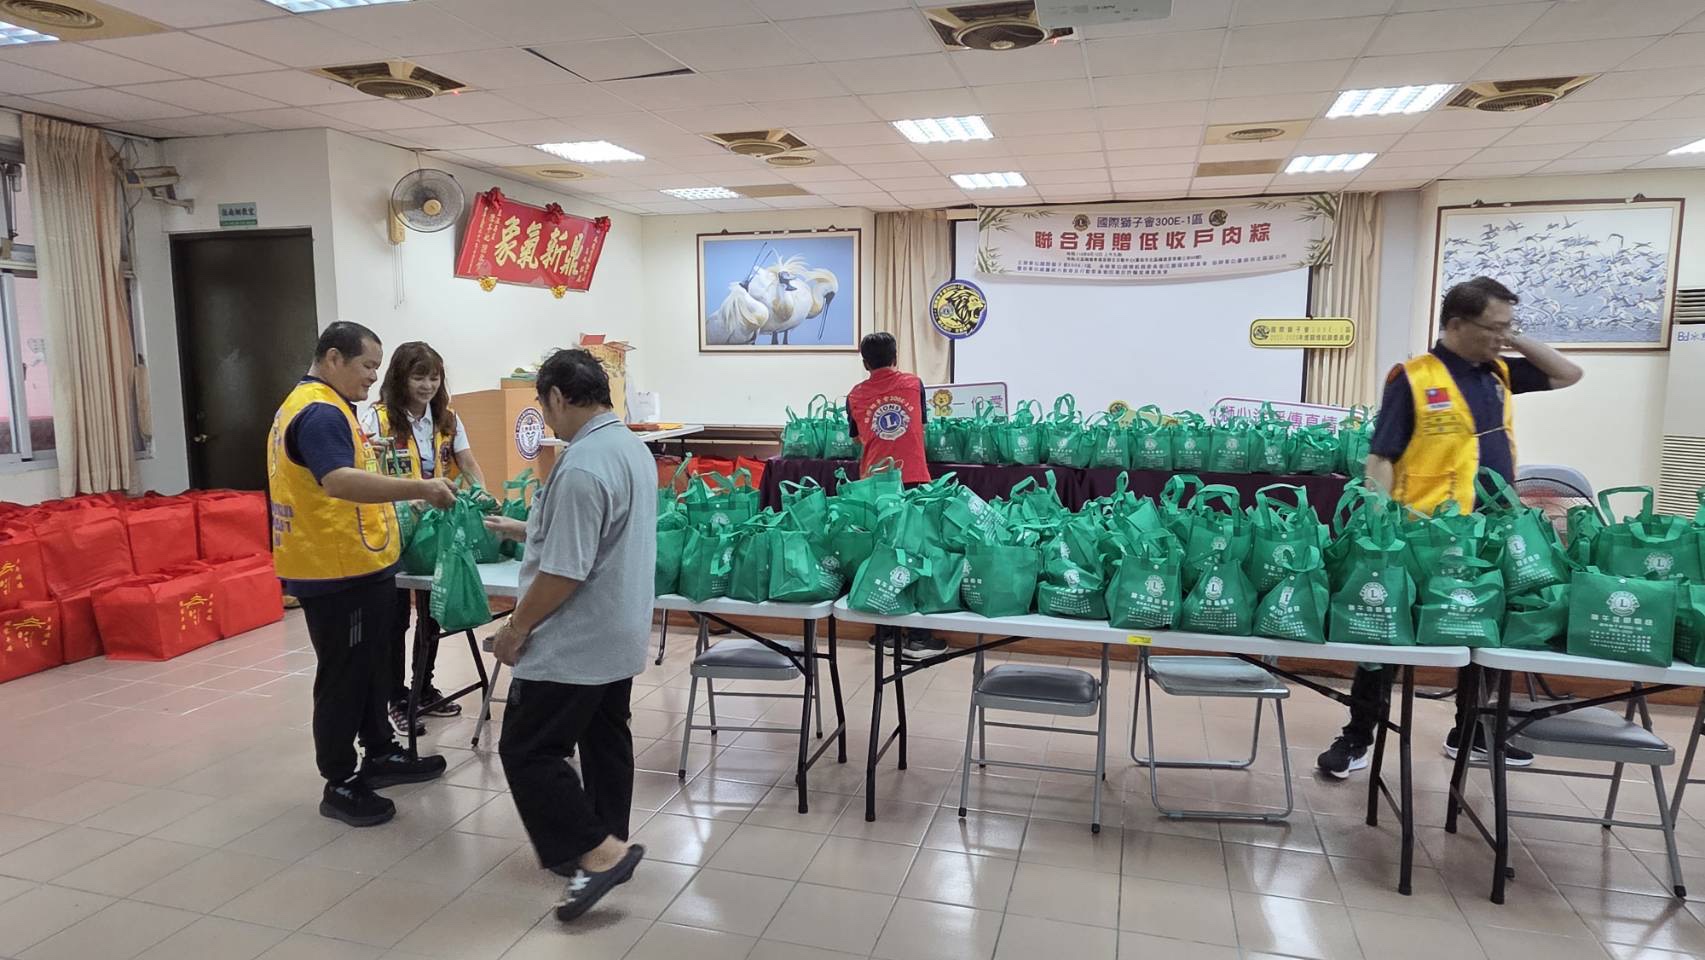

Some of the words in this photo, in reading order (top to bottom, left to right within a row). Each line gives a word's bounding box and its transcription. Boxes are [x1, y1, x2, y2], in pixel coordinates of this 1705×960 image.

[1097, 213, 1203, 228] 國際獅子會300E-1區
[1035, 222, 1272, 251] 聯合捐贈低收戶肉粽
[876, 404, 900, 416] LIONS
[884, 414, 897, 429] L
